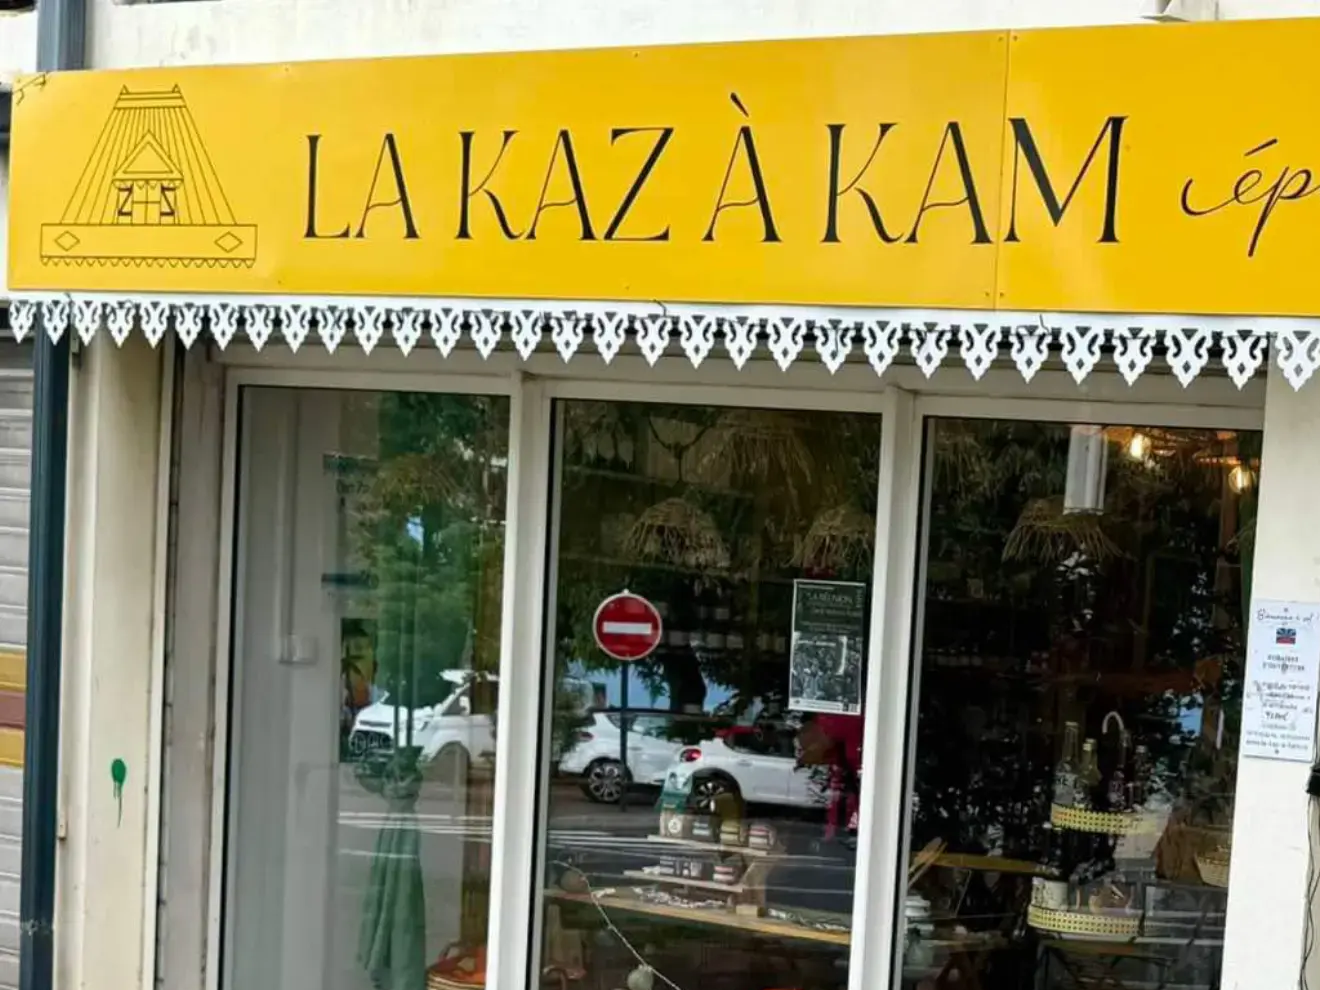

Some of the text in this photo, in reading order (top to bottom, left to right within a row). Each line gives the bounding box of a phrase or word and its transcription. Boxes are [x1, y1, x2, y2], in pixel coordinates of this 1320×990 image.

[304, 132, 419, 241] LA
[456, 126, 676, 243] KAZ
[702, 91, 782, 243] À
[818, 115, 1129, 245] KAM
